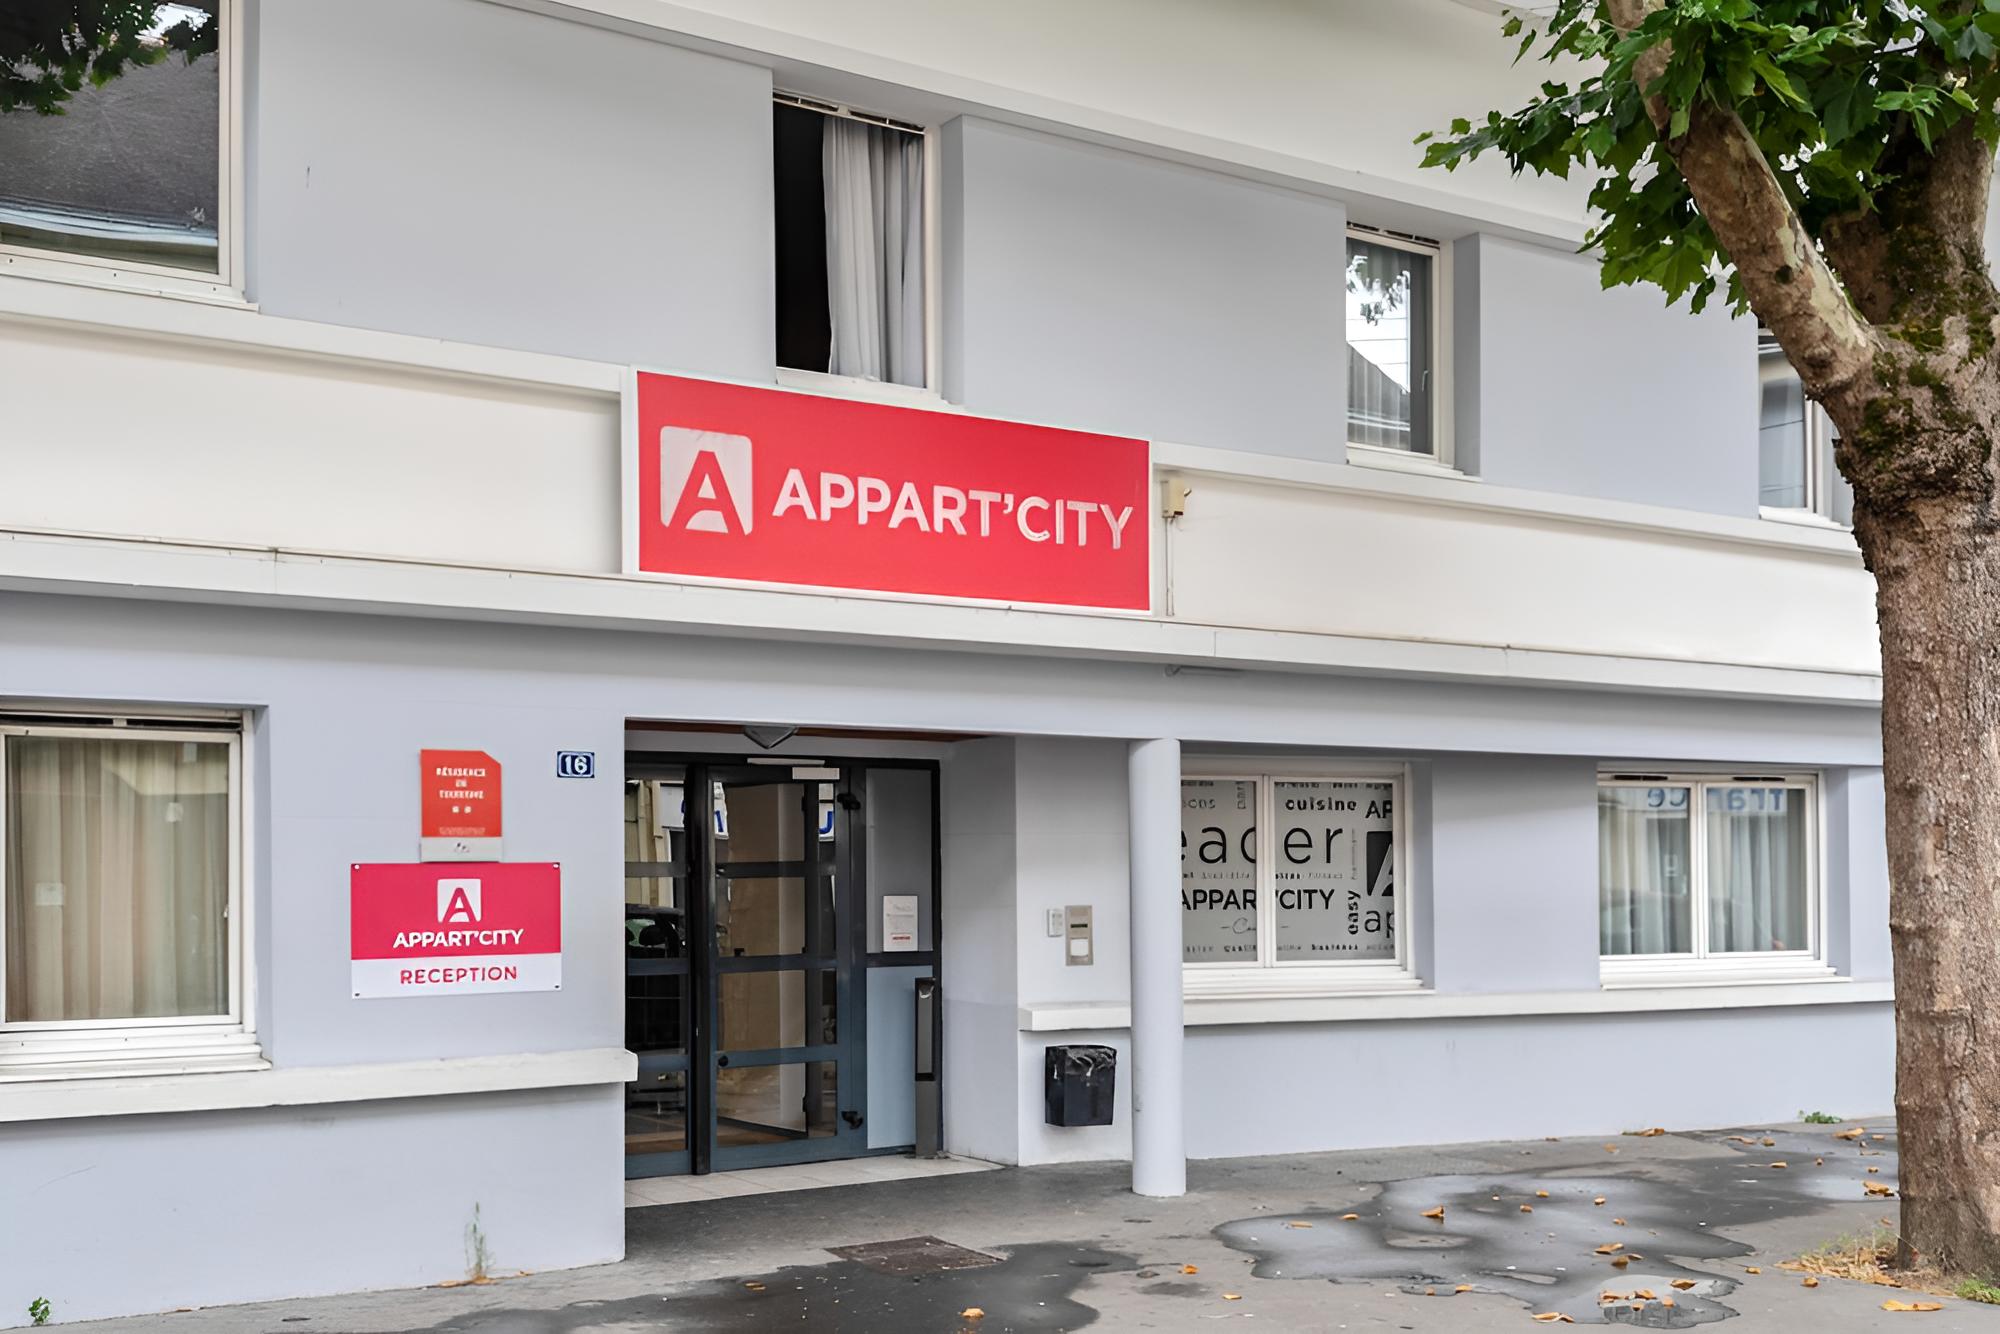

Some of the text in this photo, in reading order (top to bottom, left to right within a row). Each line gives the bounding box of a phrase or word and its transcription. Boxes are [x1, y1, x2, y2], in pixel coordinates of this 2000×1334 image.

[772, 468, 1133, 549] APPART'CITY
[564, 755, 588, 775] 16
[1181, 888, 1335, 911] APPAR'CITY
[1348, 890, 1361, 935] easy
[393, 928, 524, 949] APPART'CITY
[400, 966, 517, 984] RECEPTION
